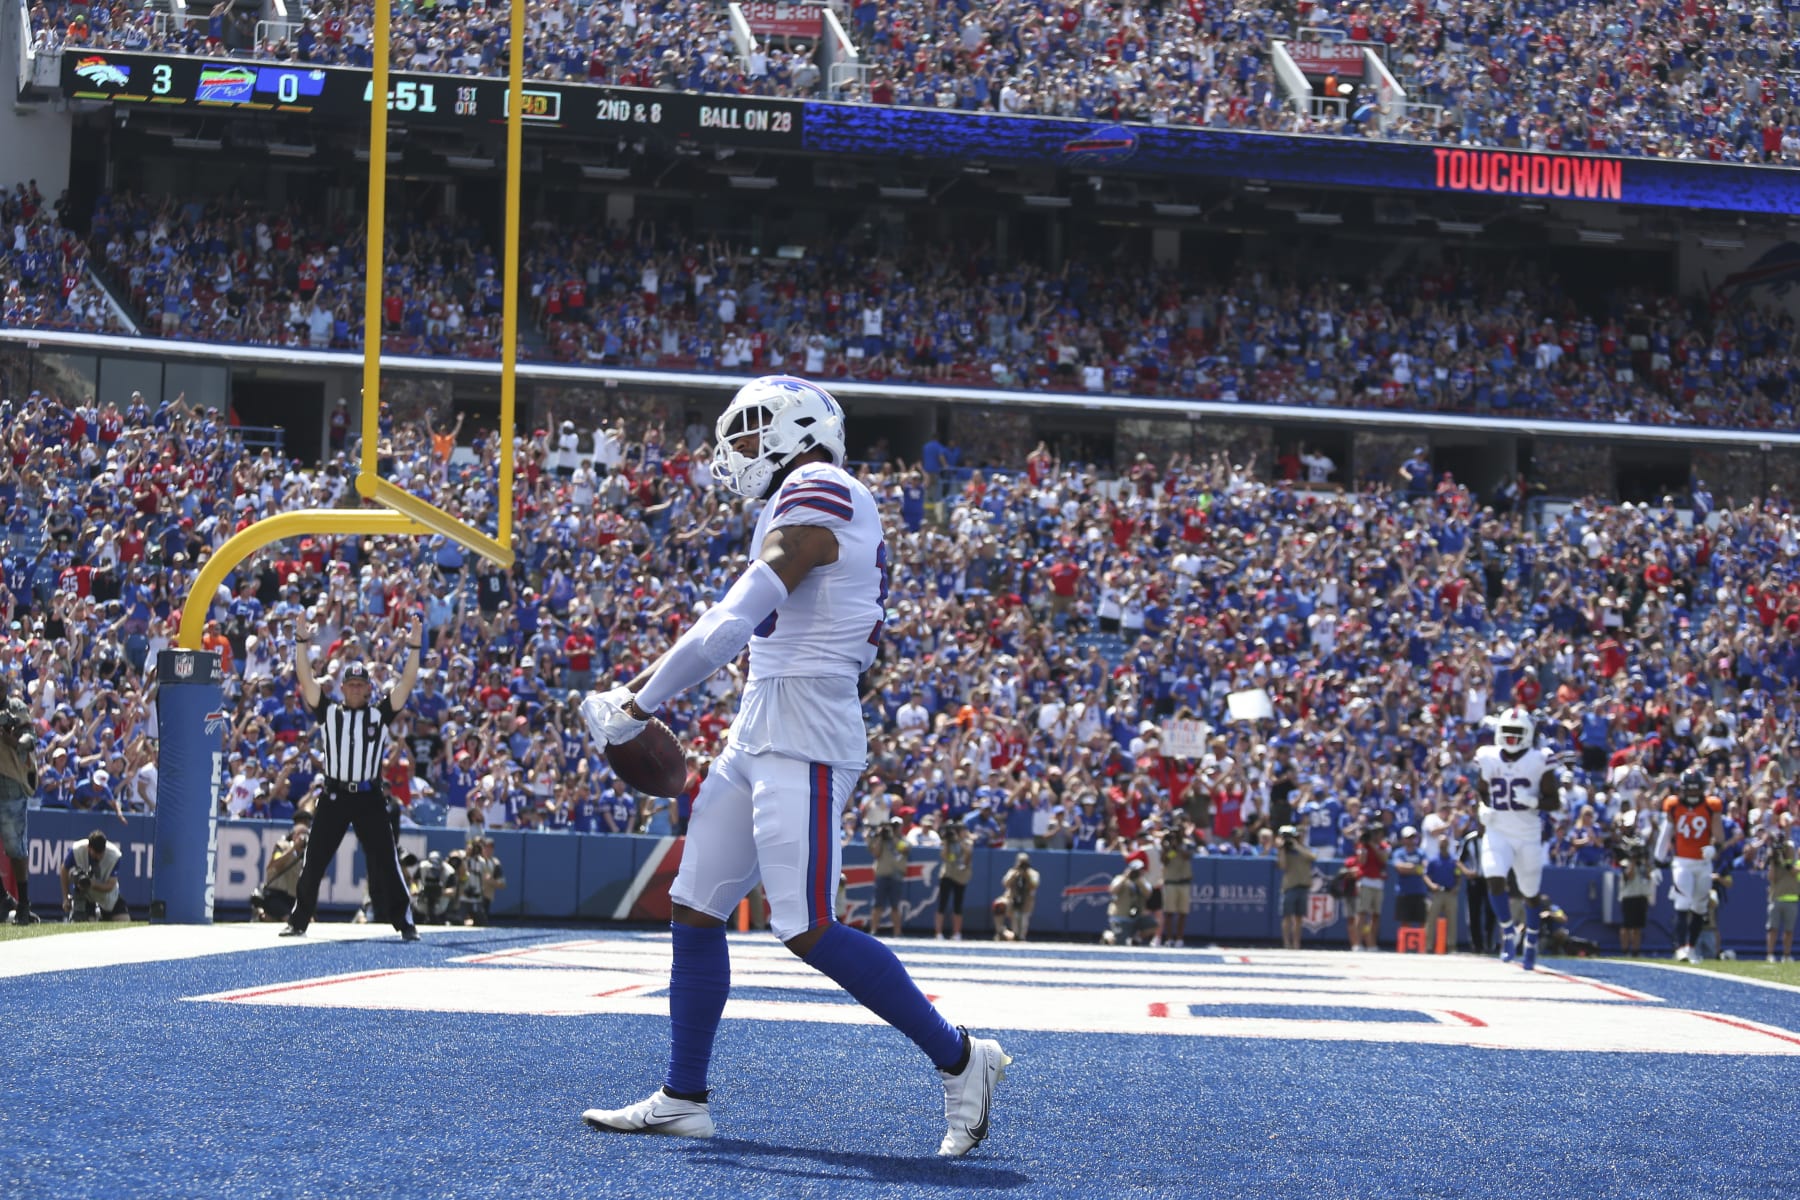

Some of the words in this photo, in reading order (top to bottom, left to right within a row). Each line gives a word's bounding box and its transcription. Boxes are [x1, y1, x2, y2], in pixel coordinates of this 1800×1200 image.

[152, 65, 172, 94] 3
[278, 73, 298, 103] 0
[456, 86, 478, 101] 1ST
[596, 100, 631, 121] 2ND
[634, 103, 647, 123] &
[651, 103, 662, 123] 8
[700, 106, 741, 129] BALL
[745, 109, 769, 130] ON
[771, 110, 792, 132] 28
[1433, 148, 1622, 200] TOUCHDOWN
[11, 575, 26, 589] 17
[62, 576, 78, 593] 25
[1677, 814, 1708, 839] 49
[1219, 885, 1266, 899] BILLS
